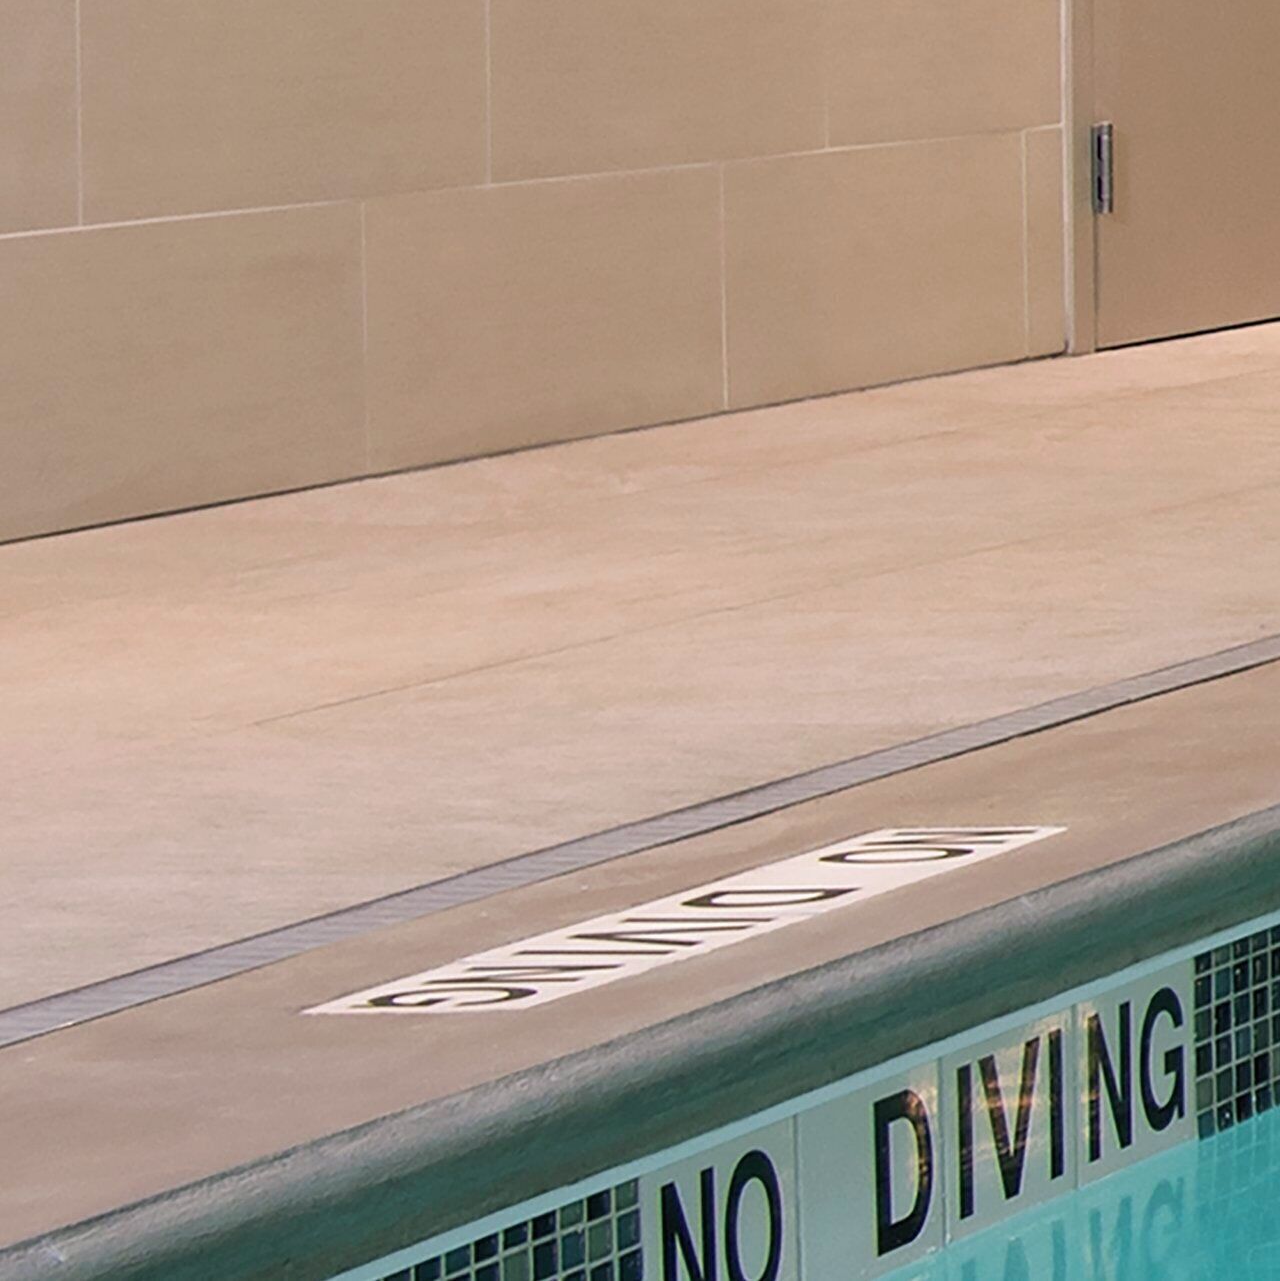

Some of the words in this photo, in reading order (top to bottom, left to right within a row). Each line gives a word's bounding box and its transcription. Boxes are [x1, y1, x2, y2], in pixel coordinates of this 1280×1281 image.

[819, 828, 1036, 865] NO
[350, 886, 861, 1008] DIVING
[660, 1149, 783, 1281] NO
[873, 987, 1184, 1258] DIVING
